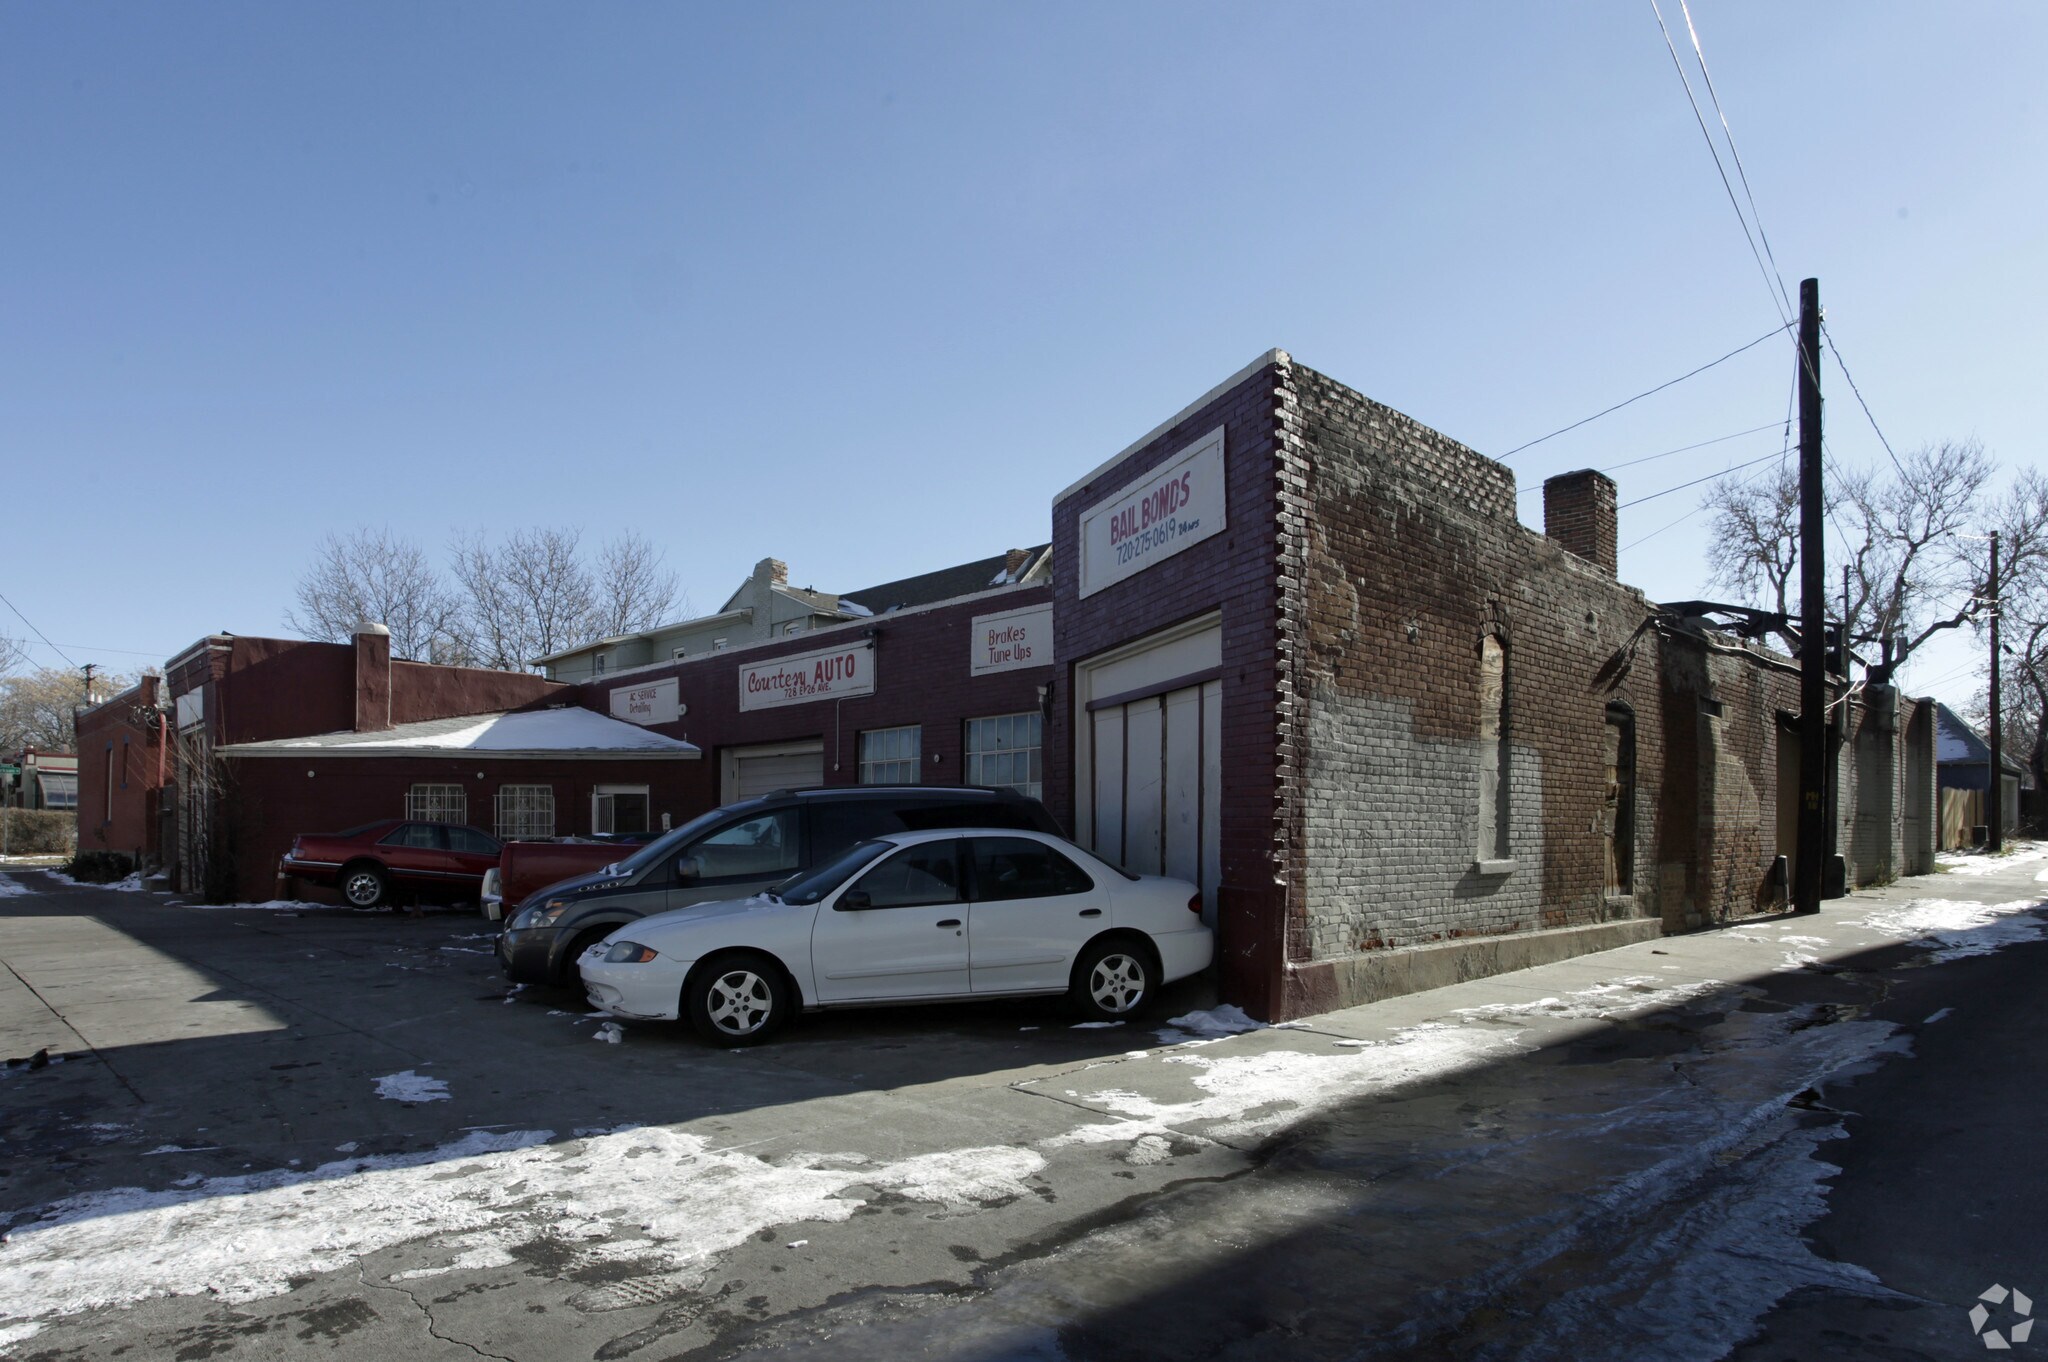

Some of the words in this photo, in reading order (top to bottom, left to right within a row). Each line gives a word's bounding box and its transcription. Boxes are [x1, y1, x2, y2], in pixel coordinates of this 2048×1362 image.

[1110, 505, 1139, 545] BAIL
[1141, 471, 1190, 529] BONDS
[988, 647, 1011, 664] Tune
[1014, 643, 1032, 661] Ups
[748, 668, 806, 693] Courtesy
[814, 654, 855, 683] AUTO
[784, 686, 797, 698] 728
